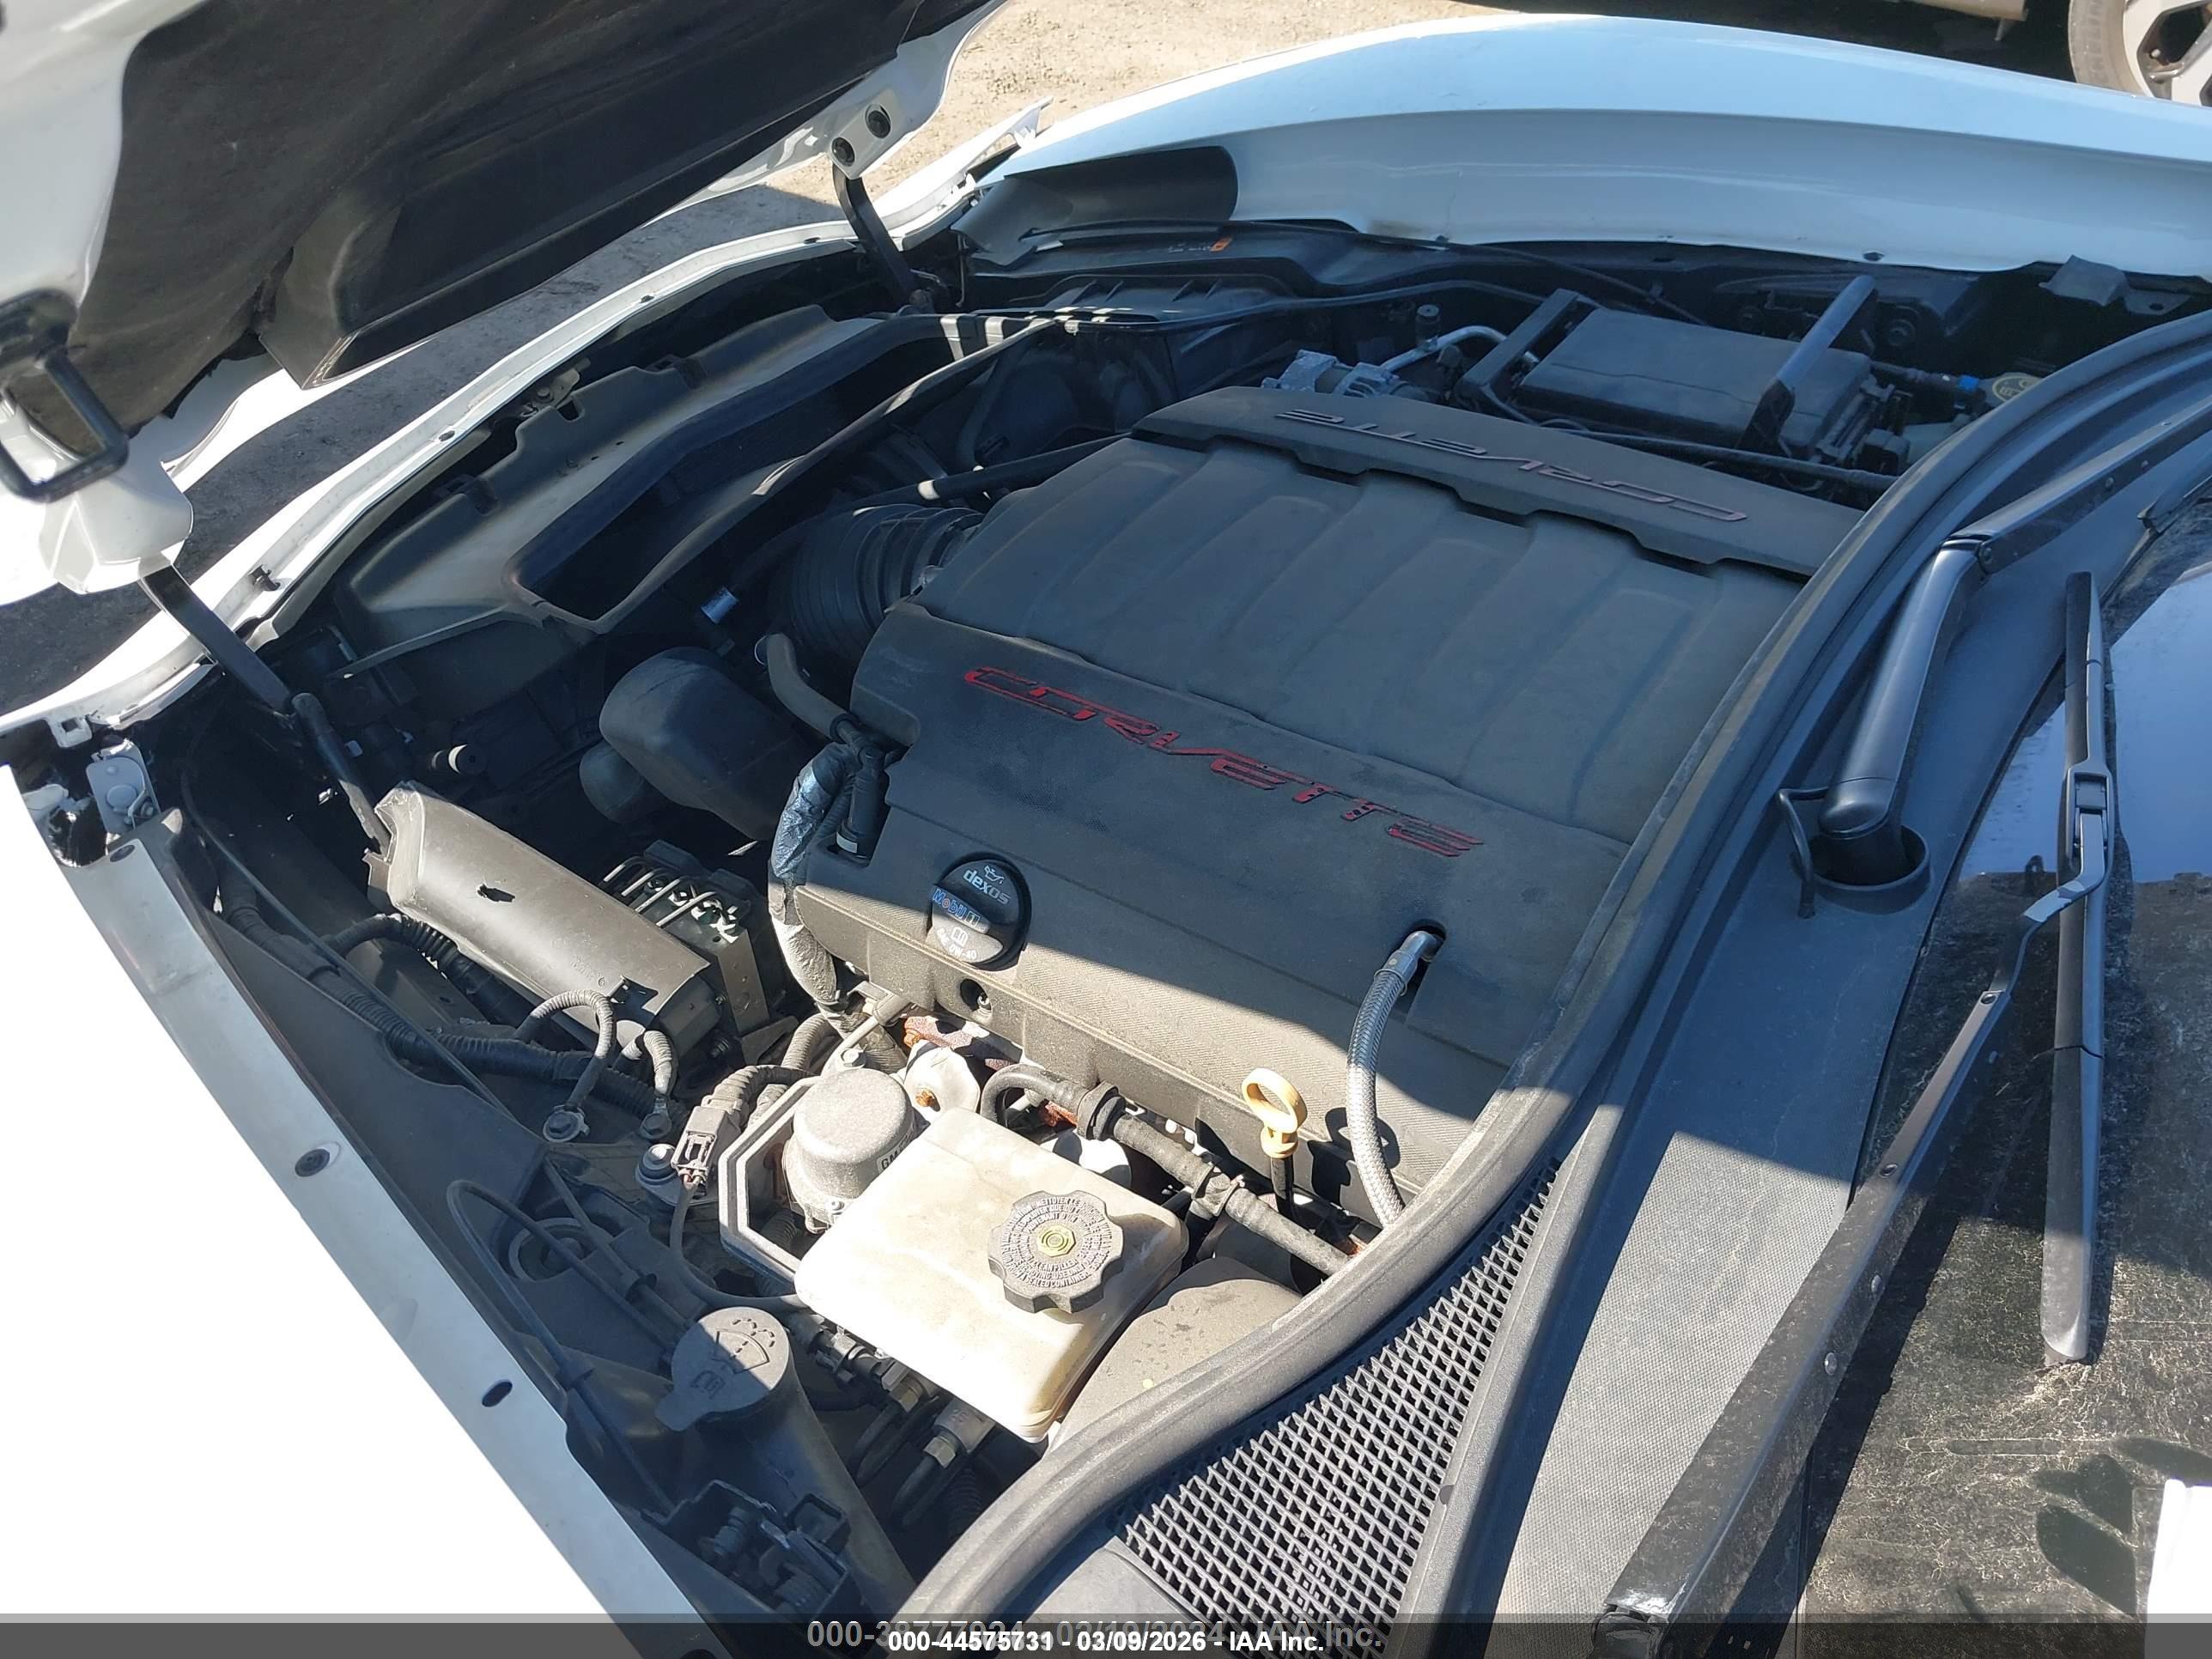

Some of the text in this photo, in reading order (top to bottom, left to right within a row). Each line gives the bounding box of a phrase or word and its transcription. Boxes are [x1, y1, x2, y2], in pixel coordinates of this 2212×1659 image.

[964, 666, 1484, 857] CORVETTE
[932, 888, 967, 919] Mobil
[963, 869, 1011, 905] dexos
